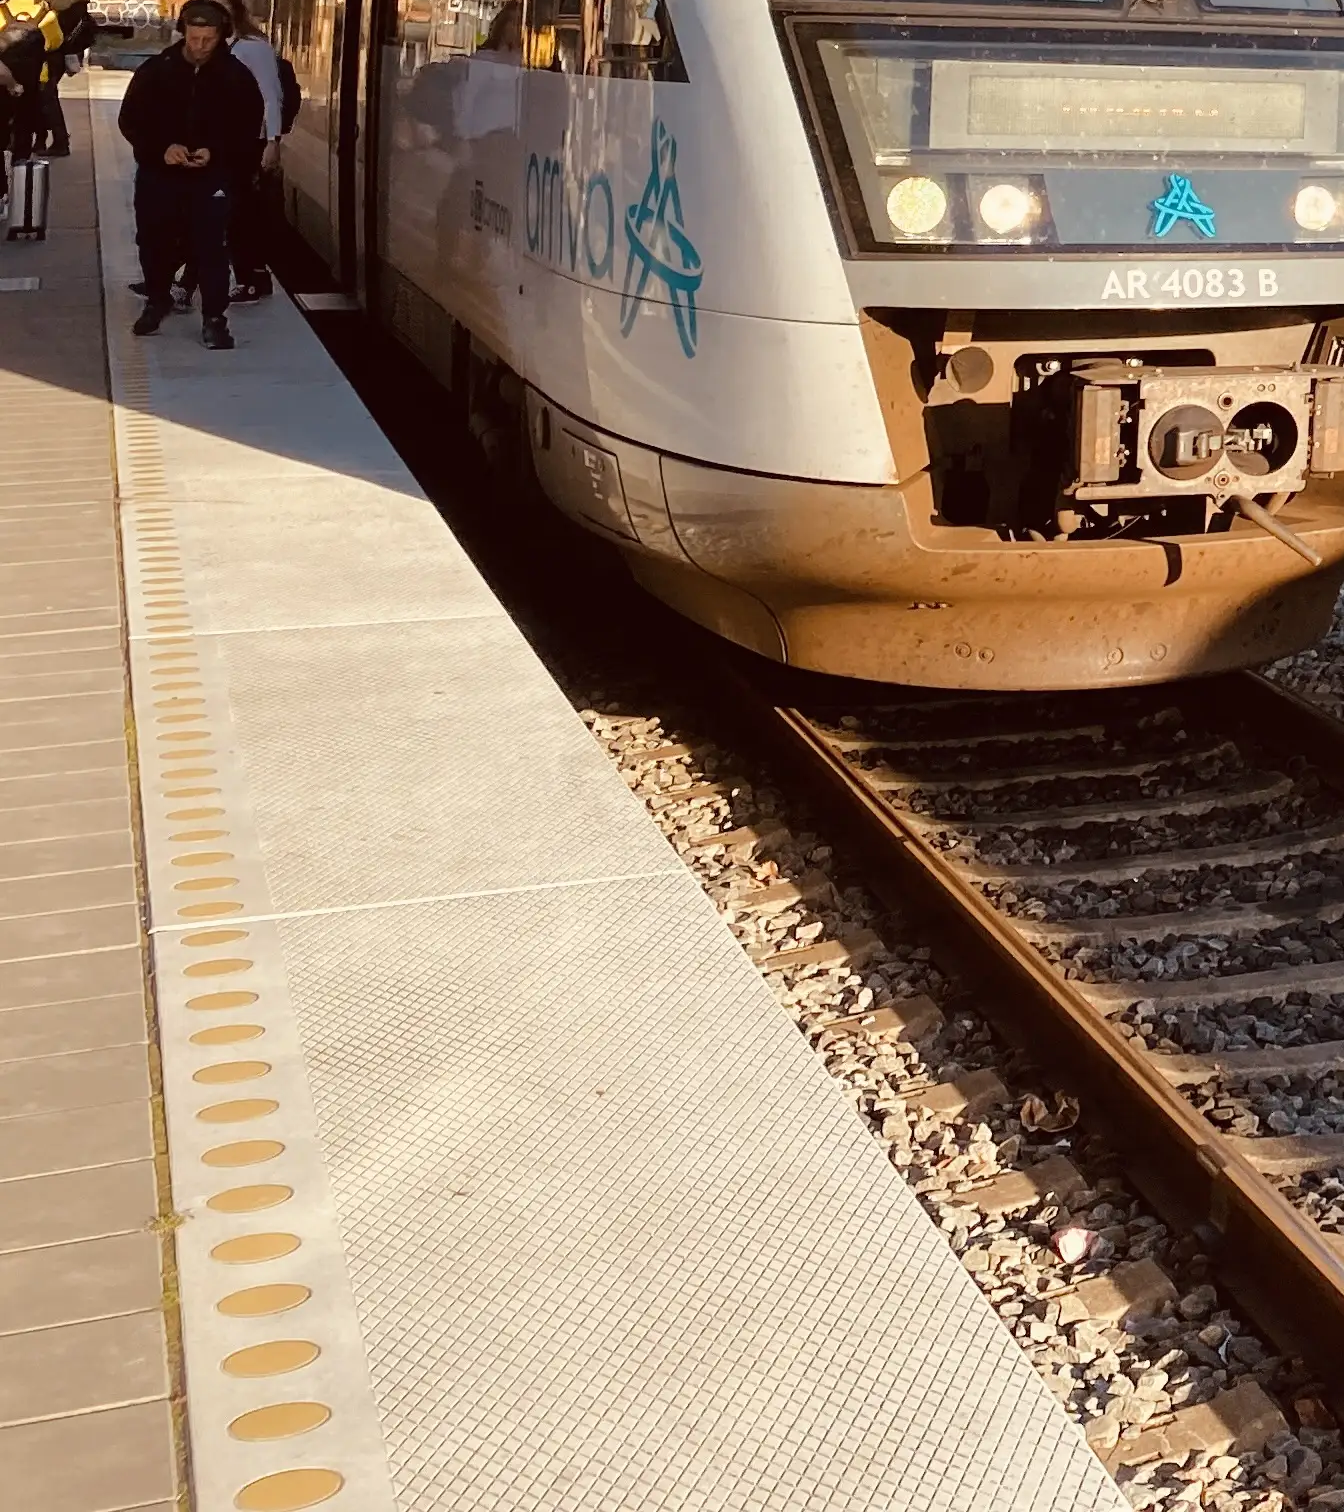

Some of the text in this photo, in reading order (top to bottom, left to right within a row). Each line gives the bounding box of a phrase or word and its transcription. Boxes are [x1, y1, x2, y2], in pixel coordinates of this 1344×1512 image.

[526, 129, 614, 285] arriva
[1101, 268, 1279, 300] AR 4083 B
